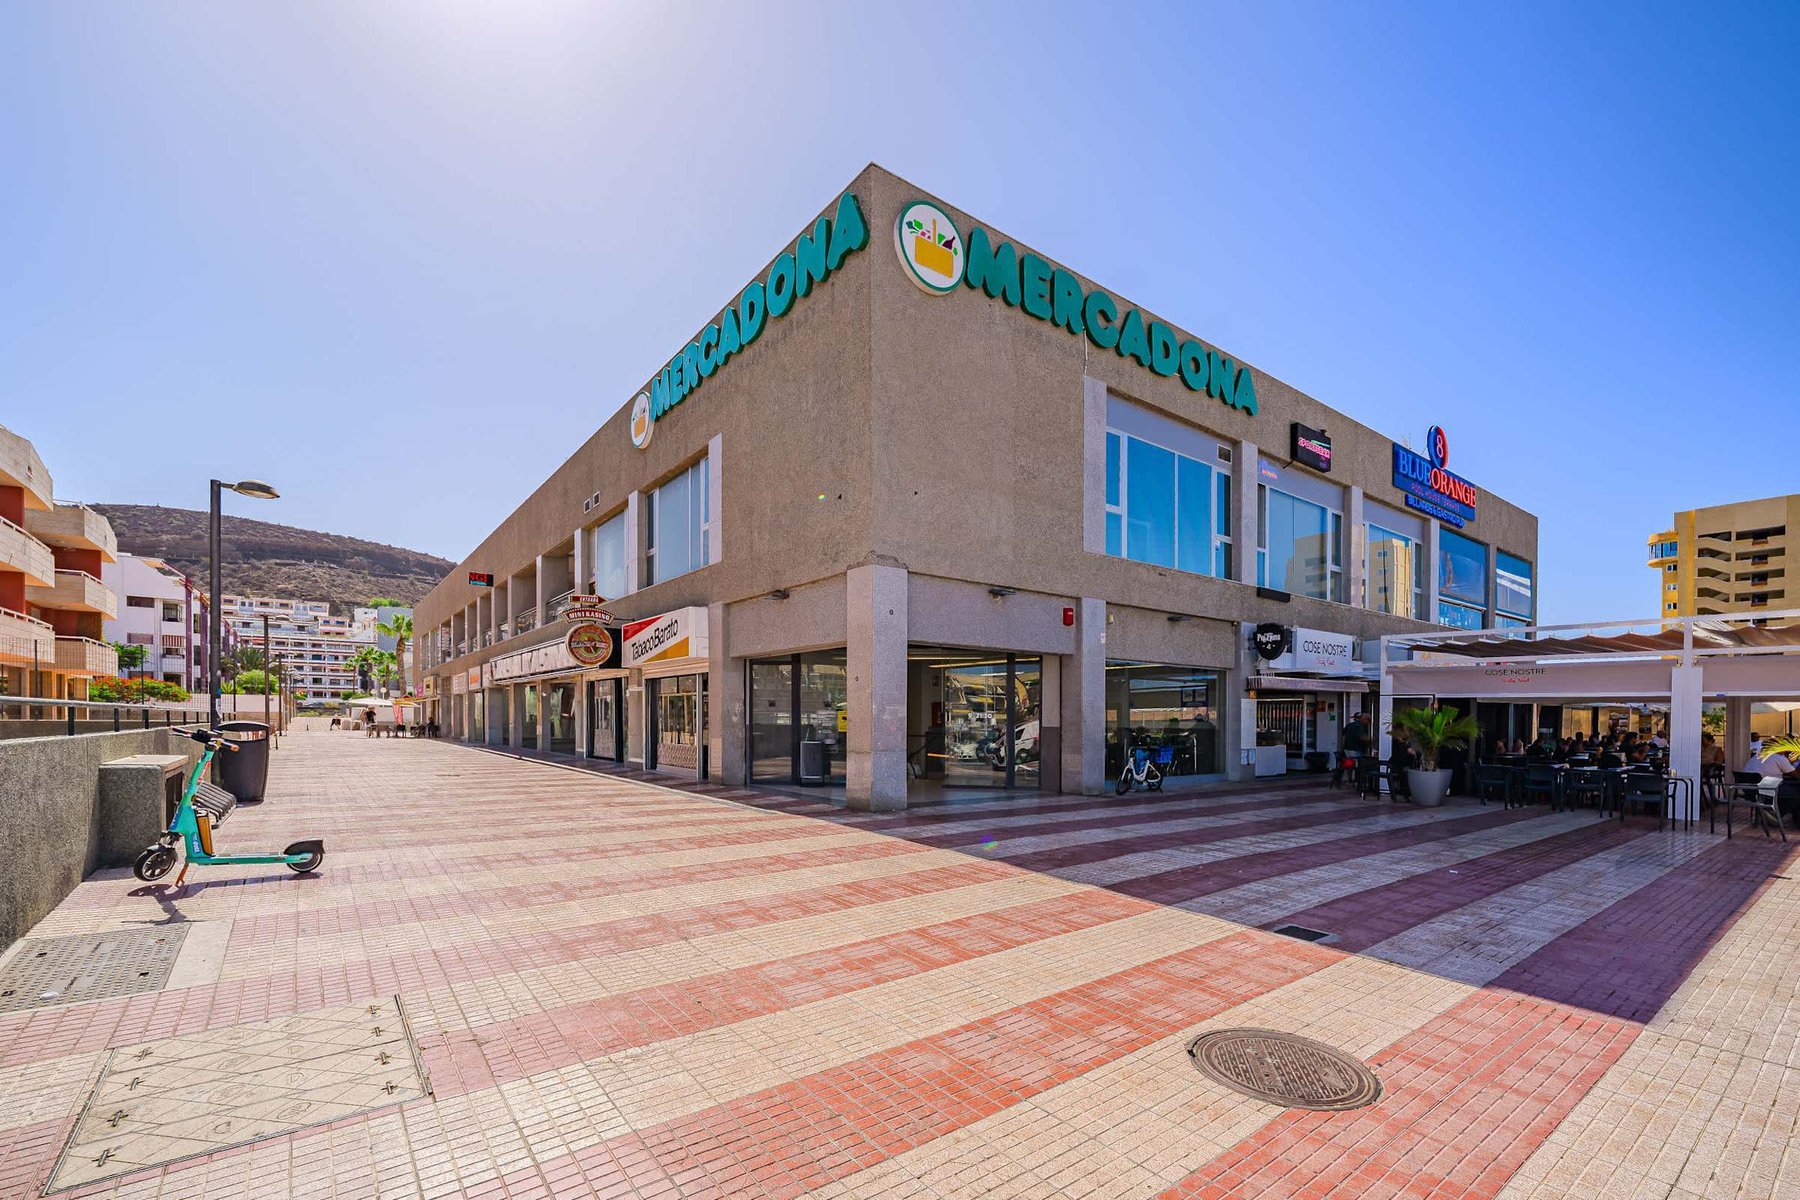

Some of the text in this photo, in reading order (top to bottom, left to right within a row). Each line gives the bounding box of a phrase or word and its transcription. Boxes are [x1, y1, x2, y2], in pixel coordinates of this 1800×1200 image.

[649, 191, 871, 421] MERCADONA
[966, 226, 1258, 417] MERCADONA
[1436, 434, 1444, 458] 8
[1303, 640, 1347, 657] COSE NOSTRE
[1485, 667, 1547, 676] COSE NOSTRE
